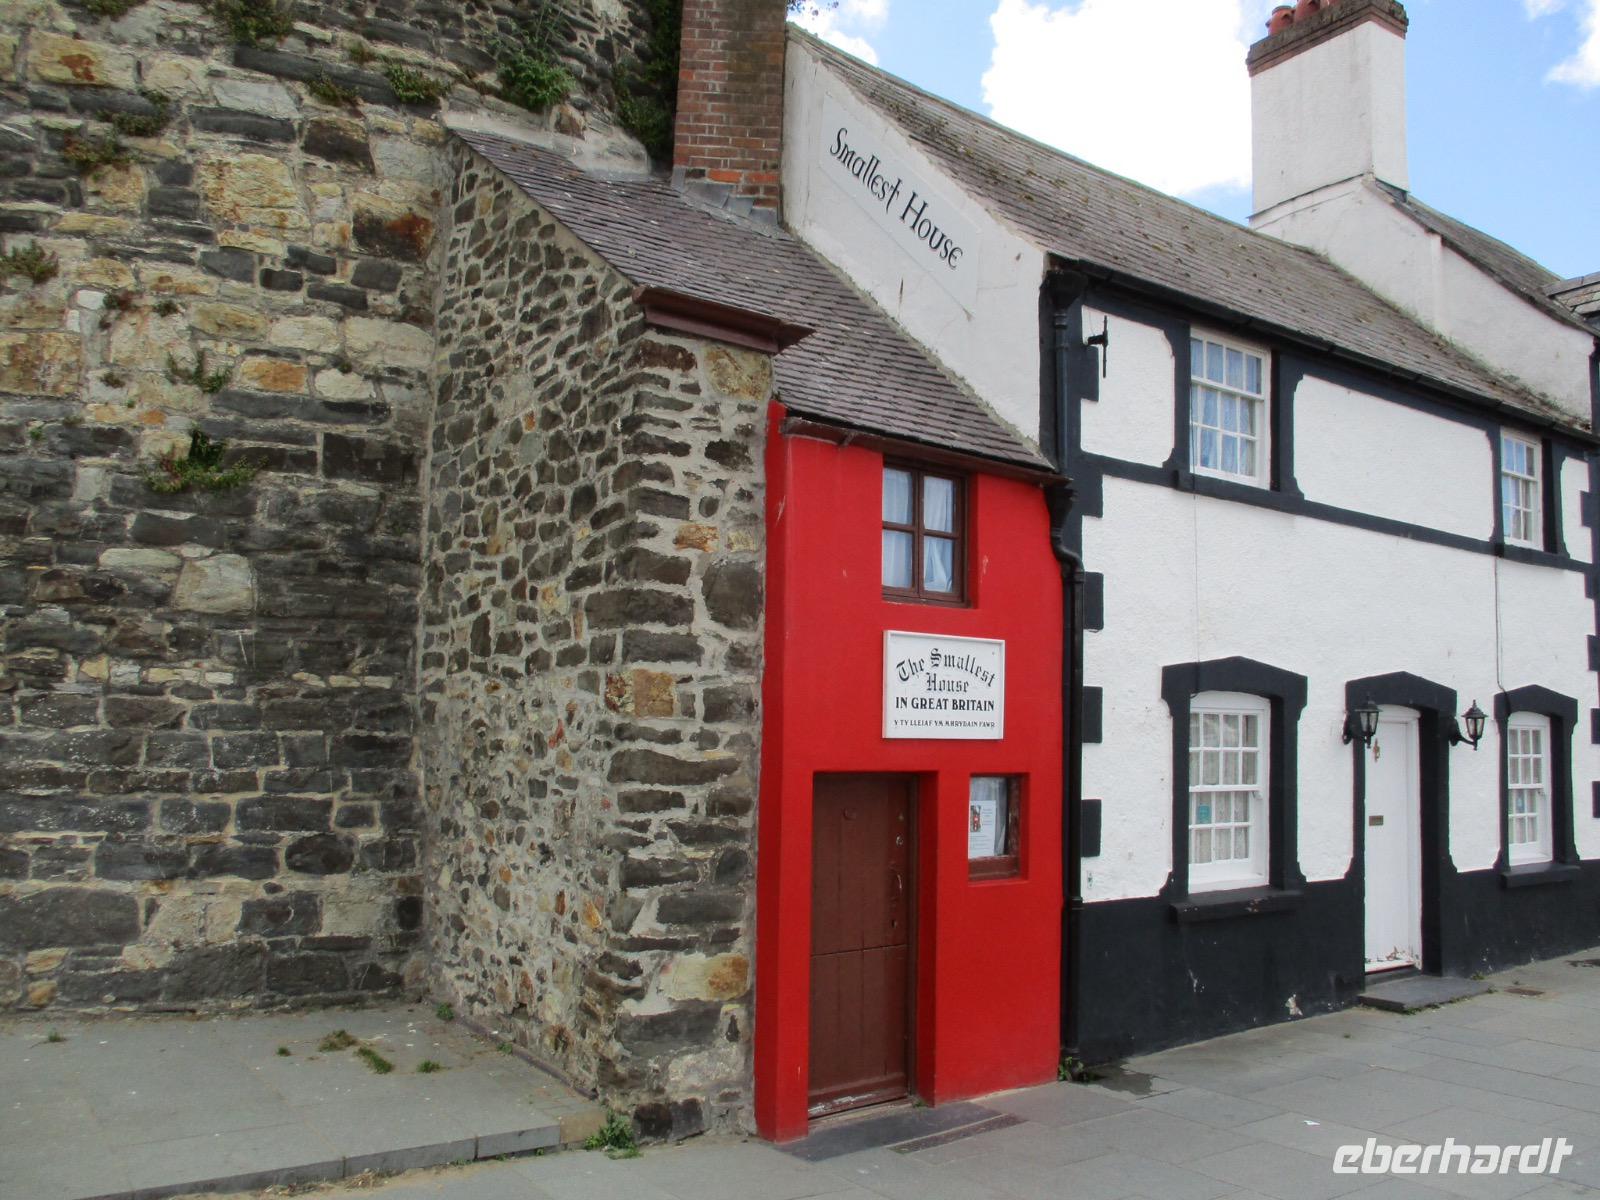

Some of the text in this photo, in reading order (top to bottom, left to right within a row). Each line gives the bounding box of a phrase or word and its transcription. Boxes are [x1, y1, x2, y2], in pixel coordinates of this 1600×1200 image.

[829, 127, 963, 270] Smallest House
[896, 647, 996, 688] The Smallest
[926, 672, 969, 693] House
[895, 696, 994, 712] IN GREAT BRITAIN
